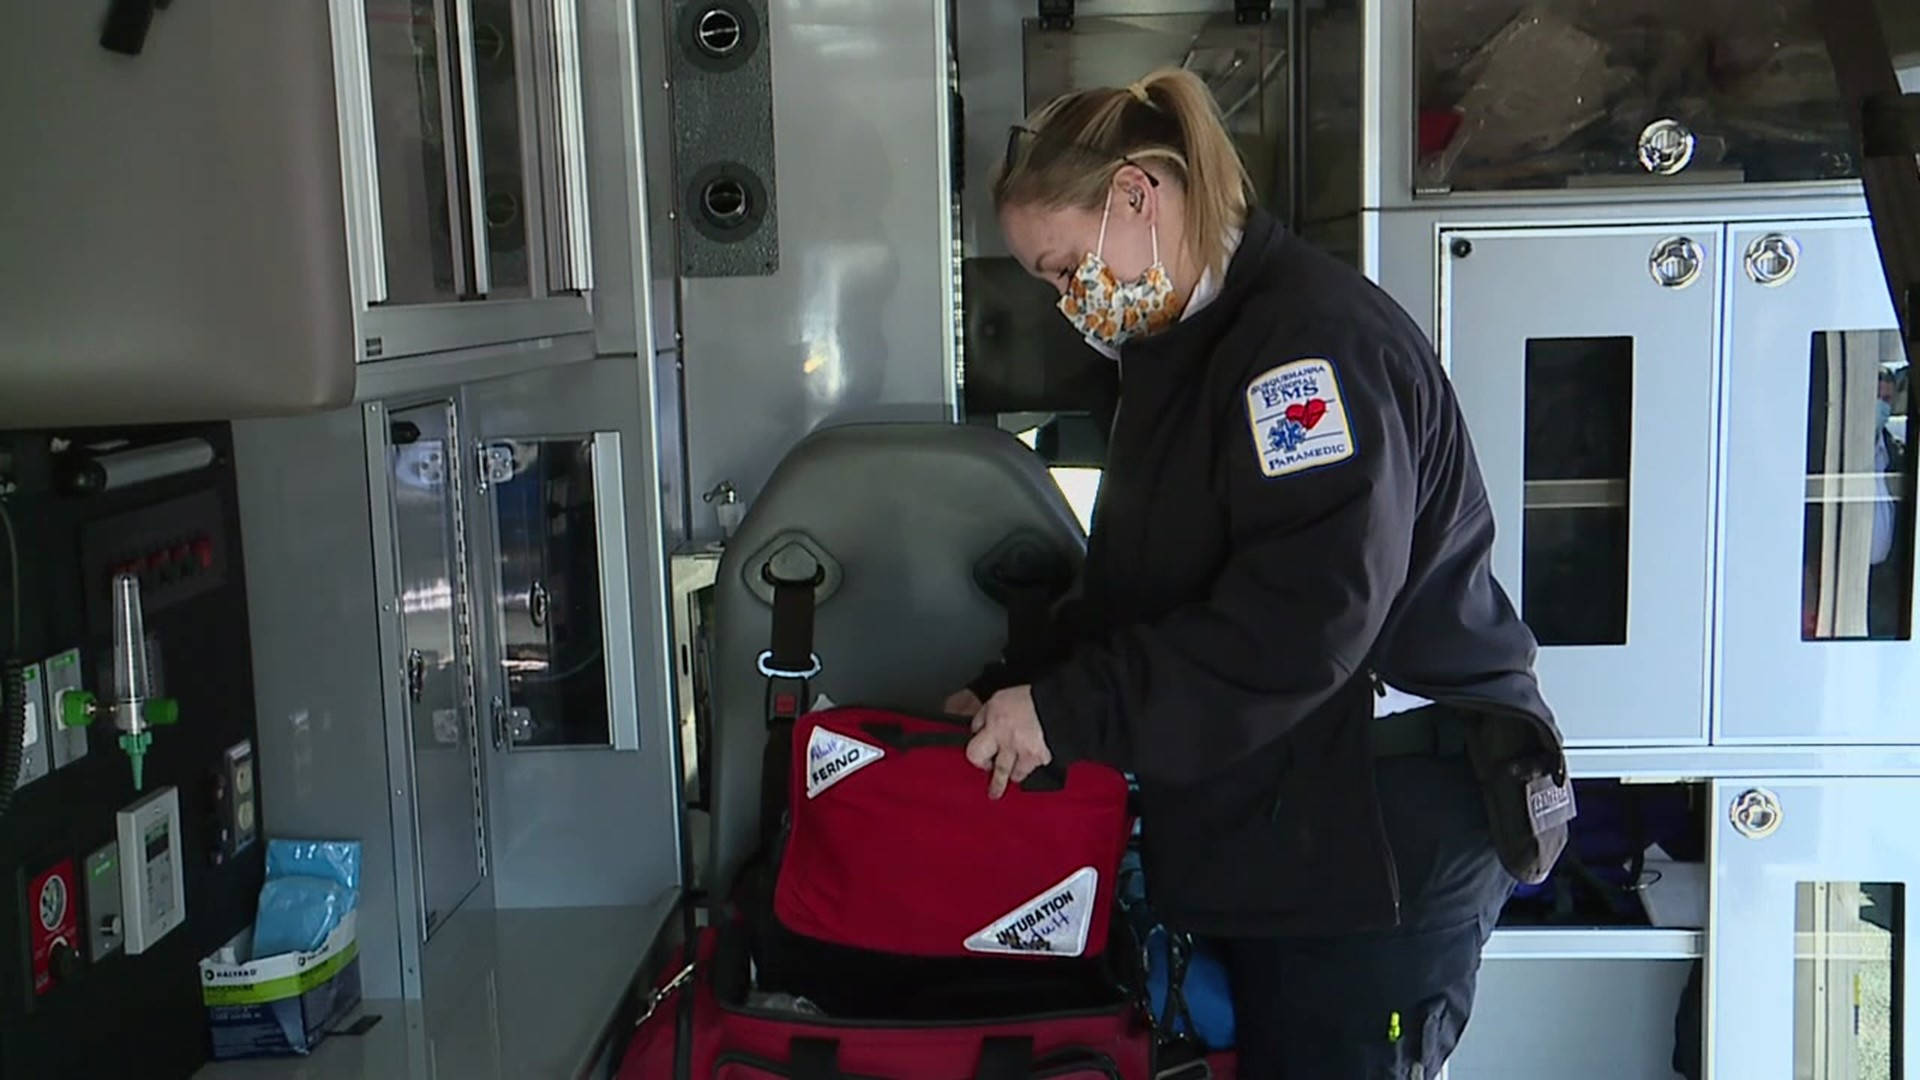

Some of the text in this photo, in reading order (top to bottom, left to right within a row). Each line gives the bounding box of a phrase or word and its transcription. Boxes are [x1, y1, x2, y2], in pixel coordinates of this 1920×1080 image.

[1263, 383, 1319, 408] EMS
[1269, 443, 1346, 470] PARAMEDIC
[812, 748, 860, 786] FERNO
[995, 889, 1075, 947] INTUBATION
